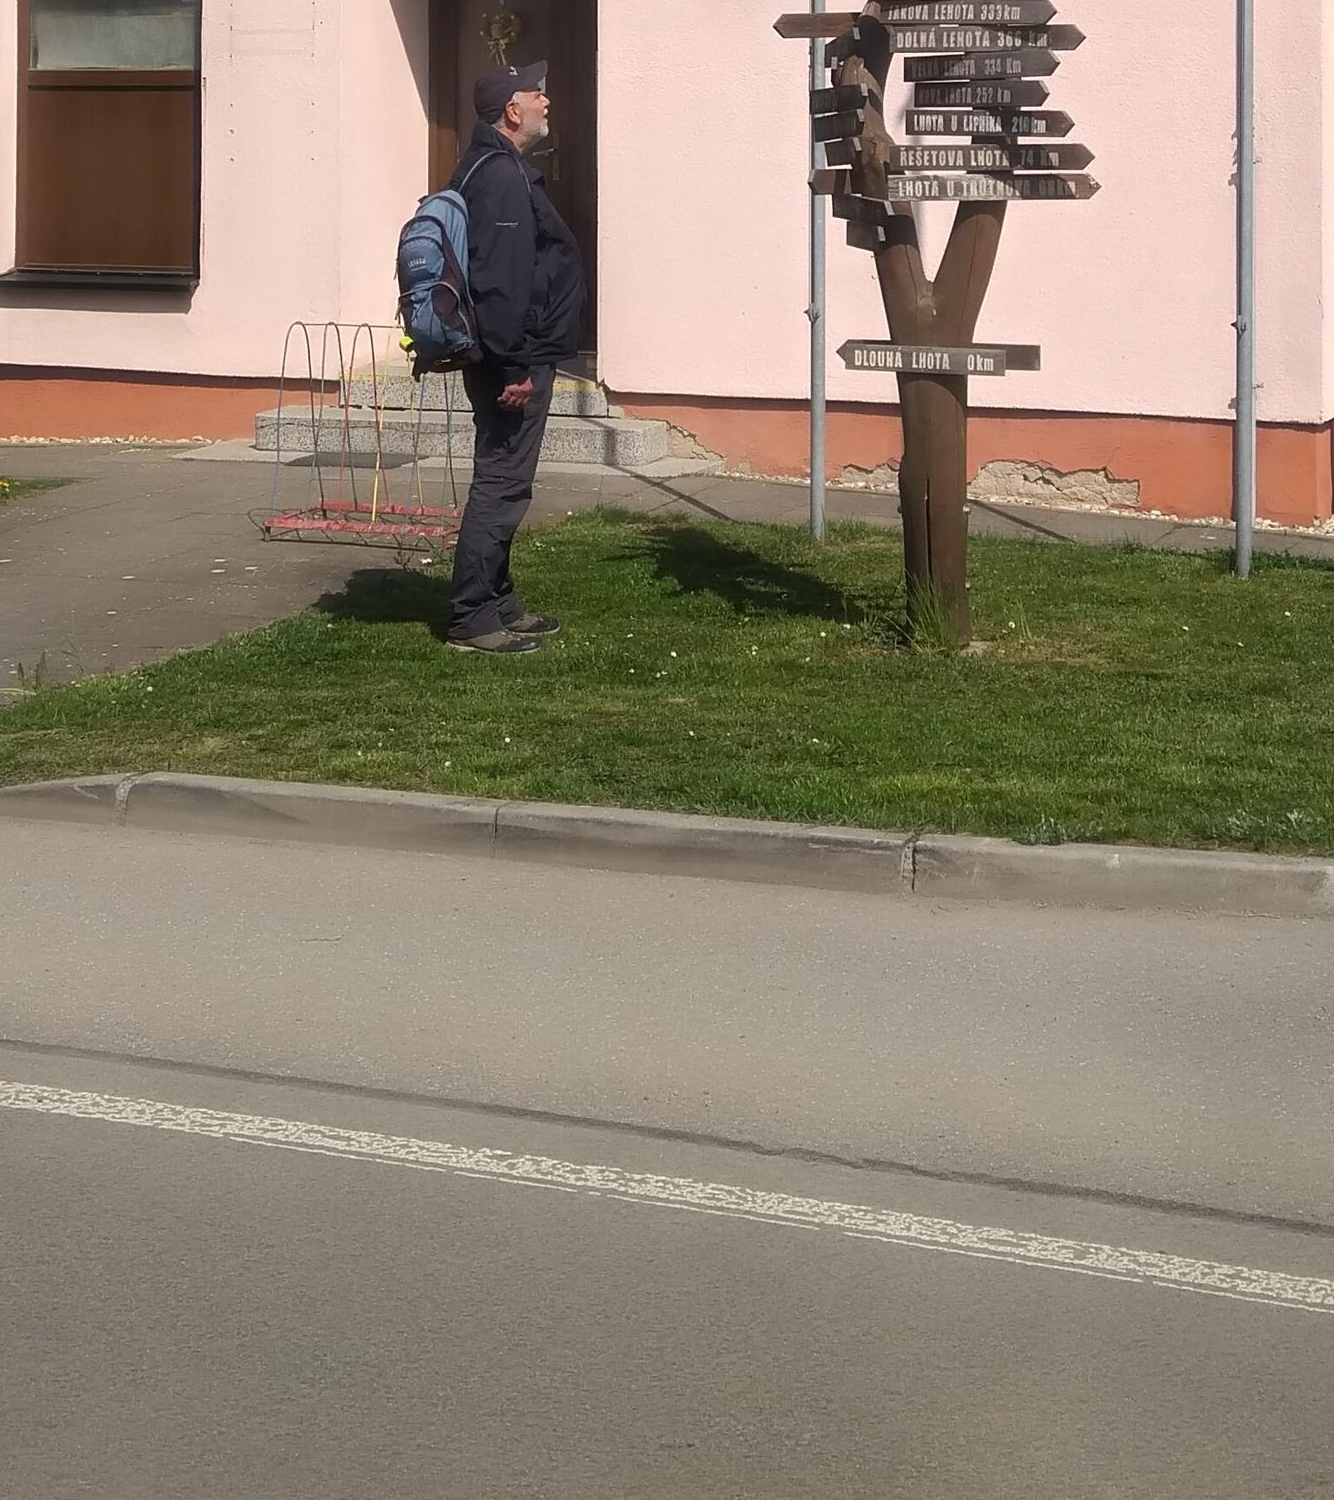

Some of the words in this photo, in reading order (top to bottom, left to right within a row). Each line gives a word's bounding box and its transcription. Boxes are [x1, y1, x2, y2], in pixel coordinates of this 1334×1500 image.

[934, 4, 974, 21] LEHOTA
[896, 27, 936, 48] DOLNÁ
[942, 30, 990, 48] LEHOTA
[944, 59, 976, 77] LEHOTA
[945, 87, 972, 104] LHOTA
[976, 87, 994, 104] 252
[914, 114, 944, 132] LHOTA
[950, 114, 958, 132] U
[963, 111, 1002, 133] LIPNÍKA
[899, 147, 964, 167] ŘEŠETOVA
[970, 149, 1010, 167] LHOTA
[898, 181, 940, 197] LHOTA
[946, 180, 955, 197] U
[854, 347, 903, 369] DLOUHÁ
[912, 352, 951, 370] LHOTA
